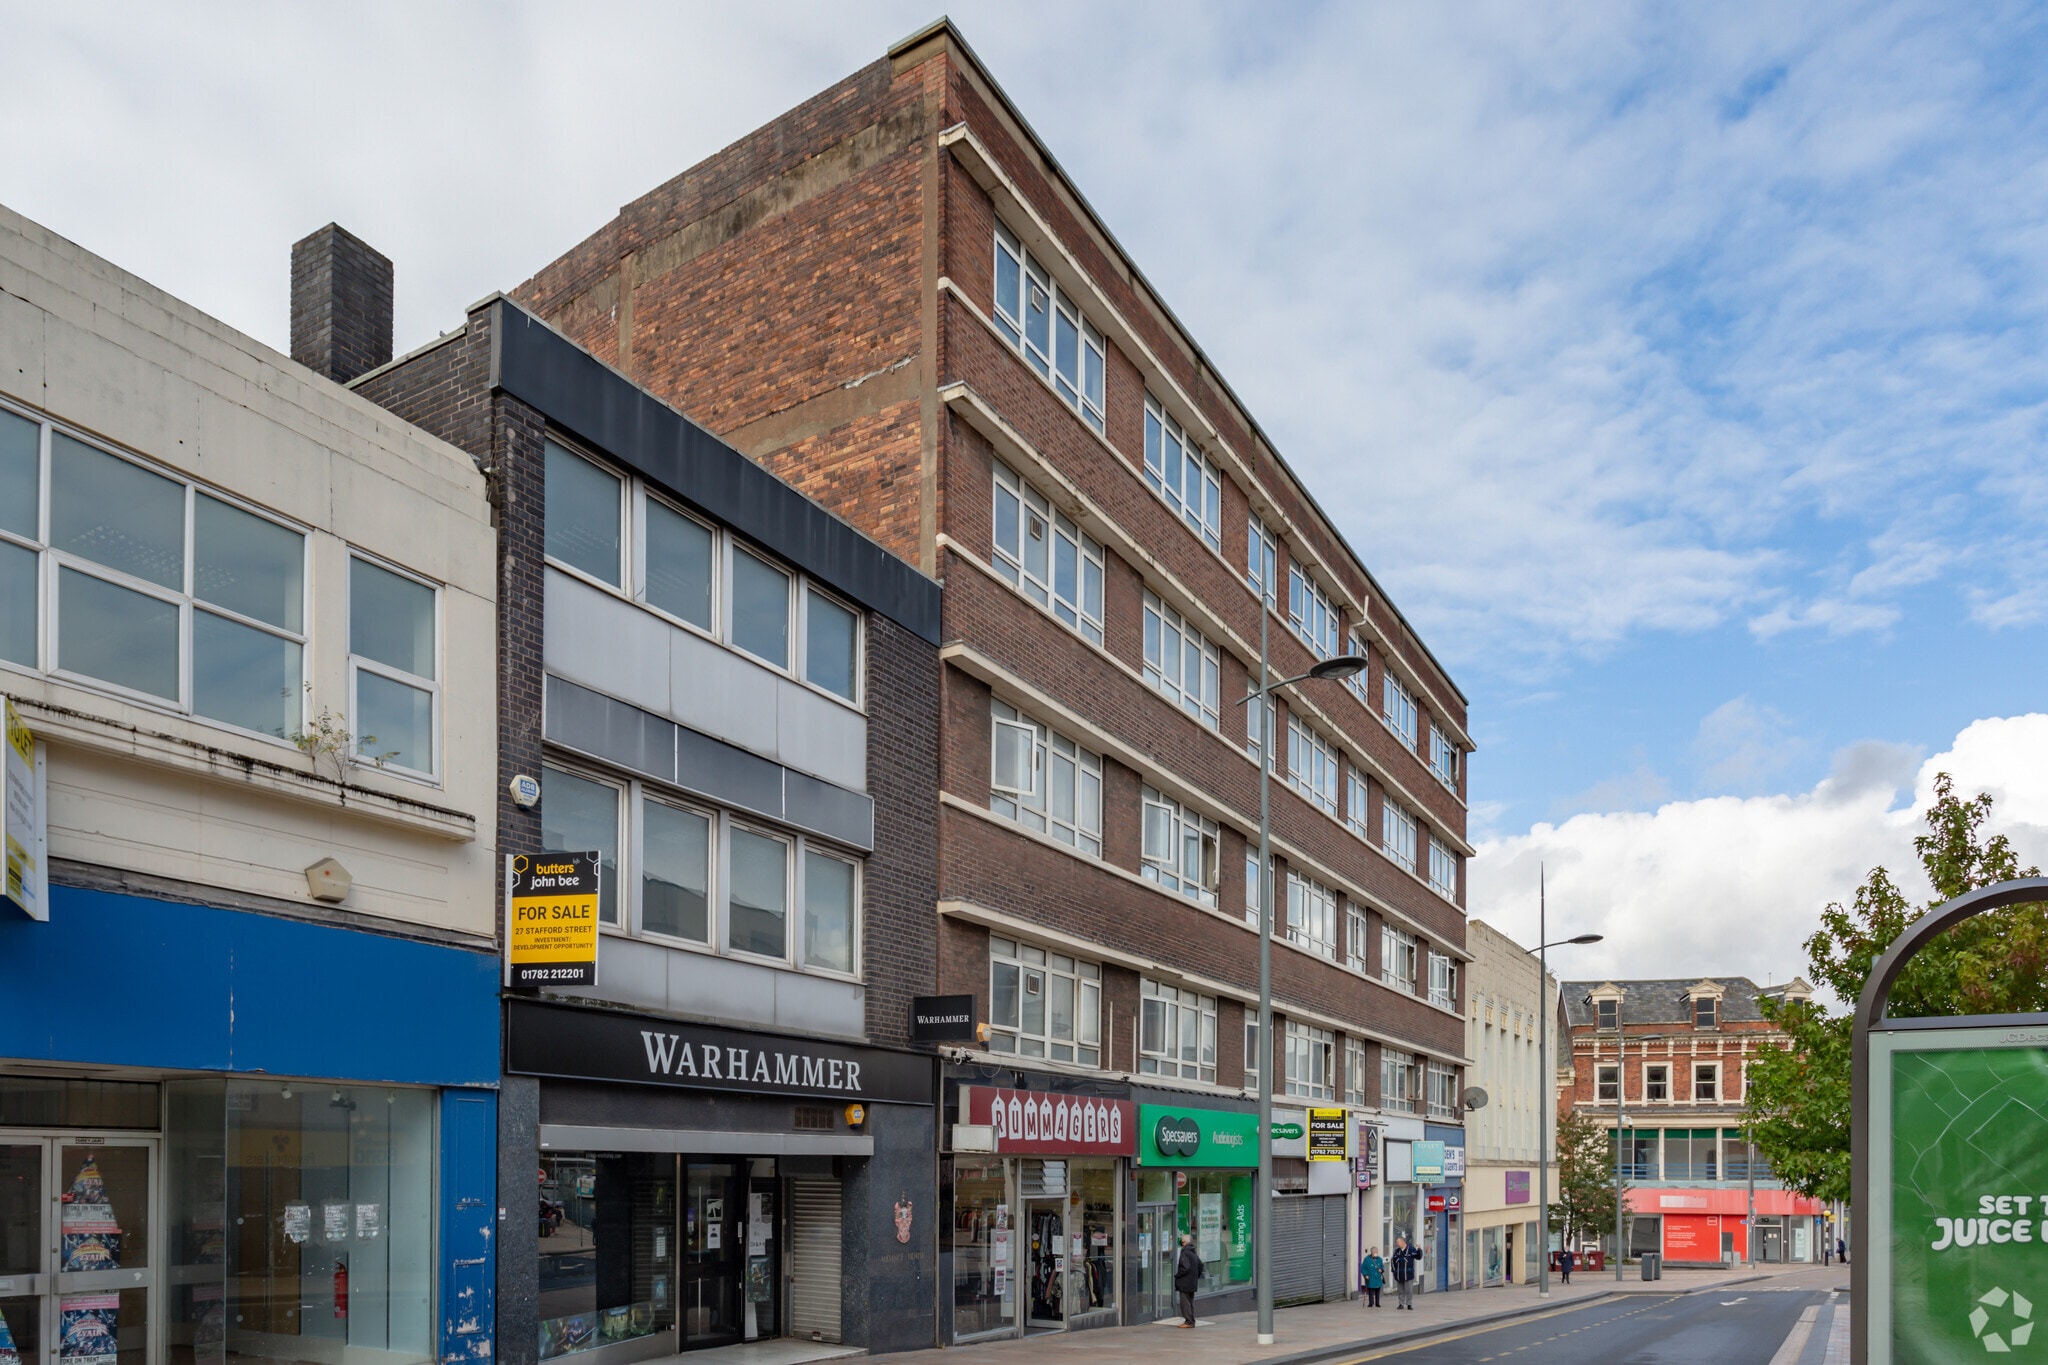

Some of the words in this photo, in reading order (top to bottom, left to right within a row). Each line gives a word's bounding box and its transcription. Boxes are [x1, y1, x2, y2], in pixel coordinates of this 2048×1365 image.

[10, 711, 20, 743] TO
[20, 728, 32, 761] LET
[536, 863, 574, 875] butters
[530, 876, 556, 890] john
[558, 875, 580, 886] bee
[518, 906, 547, 920] FOR
[552, 905, 590, 919] SALE
[525, 926, 563, 934] STAFFORD
[564, 926, 592, 934] STREET
[522, 970, 549, 980] 01782
[550, 968, 584, 978] 212201
[917, 1014, 970, 1025] WARHAMMER
[640, 1031, 862, 1091] WARHAMMER
[995, 1110, 1121, 1138] RUMMAGERS
[1162, 1126, 1198, 1144] Specsavers
[1212, 1130, 1243, 1146] Audiologists
[1237, 1204, 1245, 1221] Aids
[1978, 1195, 2032, 1216] SET
[1236, 1222, 1246, 1252] Hearing
[1931, 1217, 2032, 1251] JUICE
